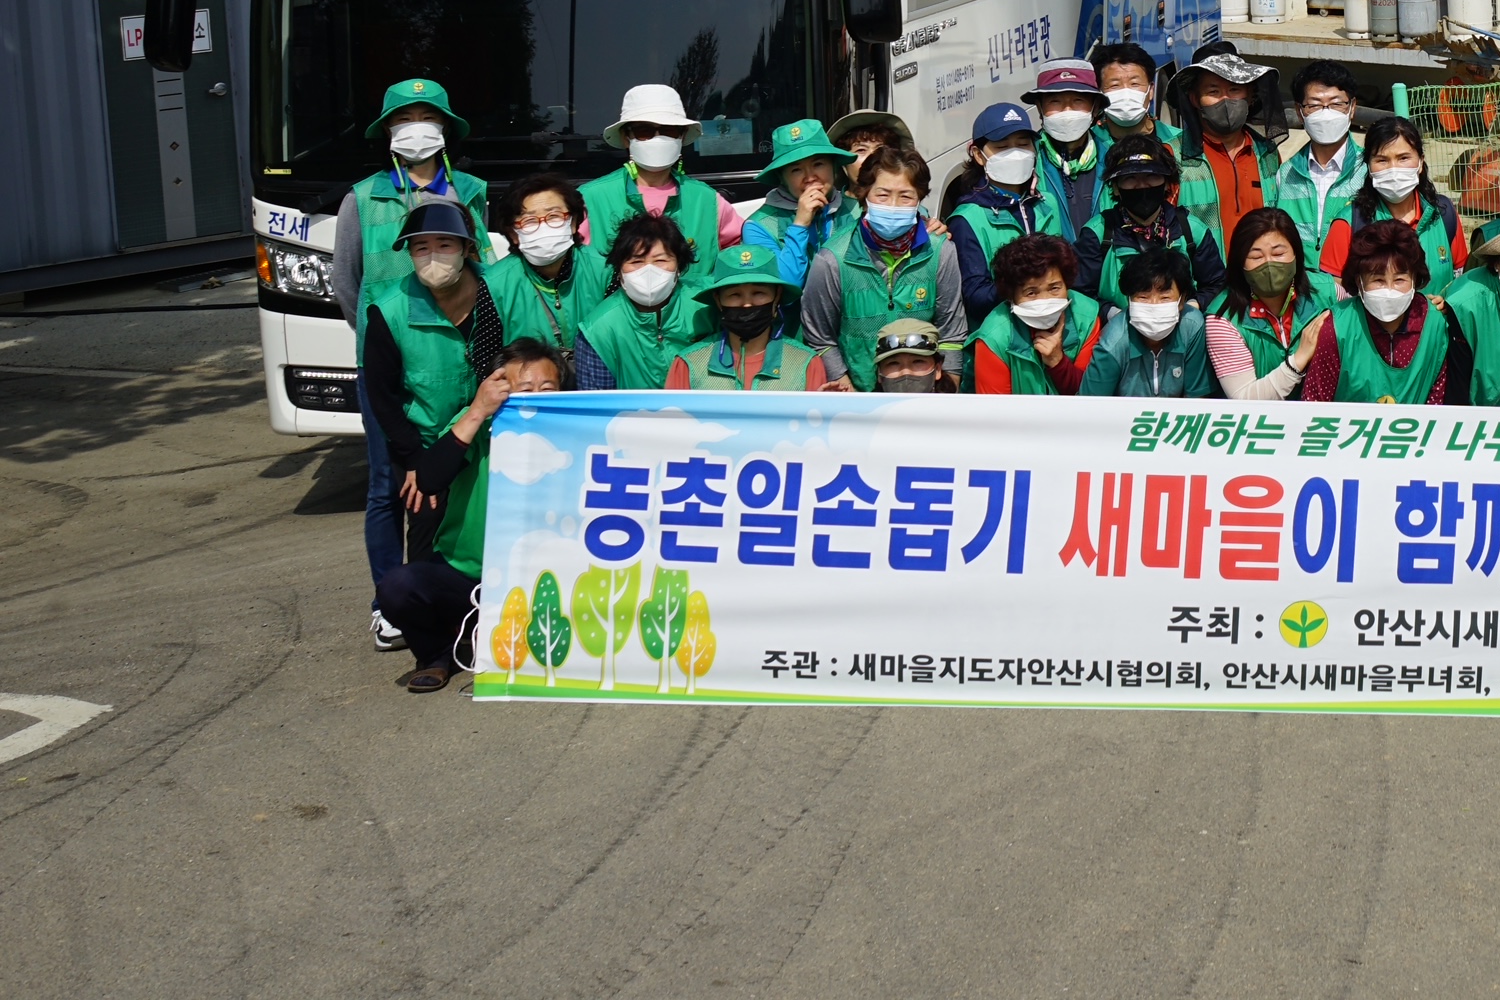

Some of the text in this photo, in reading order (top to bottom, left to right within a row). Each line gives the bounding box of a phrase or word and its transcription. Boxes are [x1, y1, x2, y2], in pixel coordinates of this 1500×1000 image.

[987, 14, 1051, 83] 신나라관광
[936, 74, 946, 94] 본사
[268, 211, 311, 242] 전세
[1126, 411, 1285, 455] 함께하는
[1297, 417, 1437, 459] 즐거움!
[584, 453, 1032, 574] 농촌일손돕기
[1058, 471, 1359, 583] 새마을이
[1167, 606, 1240, 645] 주최
[761, 650, 820, 680] 주관
[848, 653, 1211, 691] 새마을지도자안산시협의회,
[1222, 662, 1491, 696] 안산시새마을부녀회,
